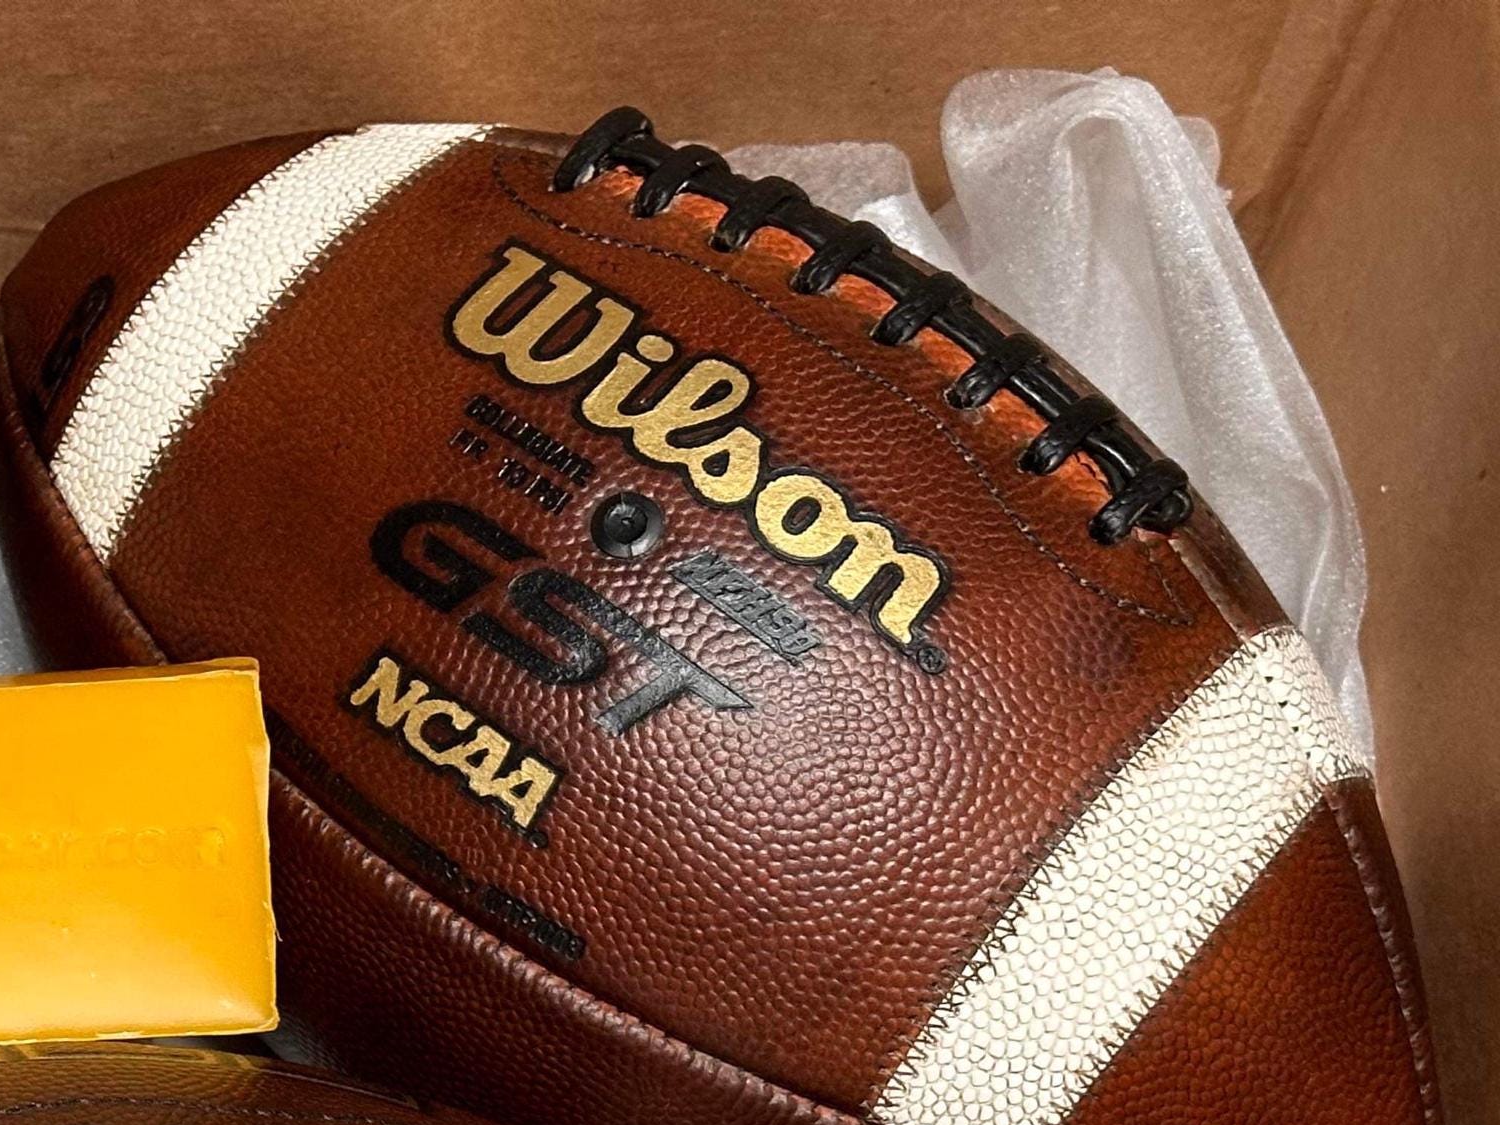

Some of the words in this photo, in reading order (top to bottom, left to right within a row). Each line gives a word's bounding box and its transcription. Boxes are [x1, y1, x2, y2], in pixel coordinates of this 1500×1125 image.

[443, 236, 951, 651] Wilson
[370, 498, 755, 737] GST
[341, 650, 567, 832] NCAA
